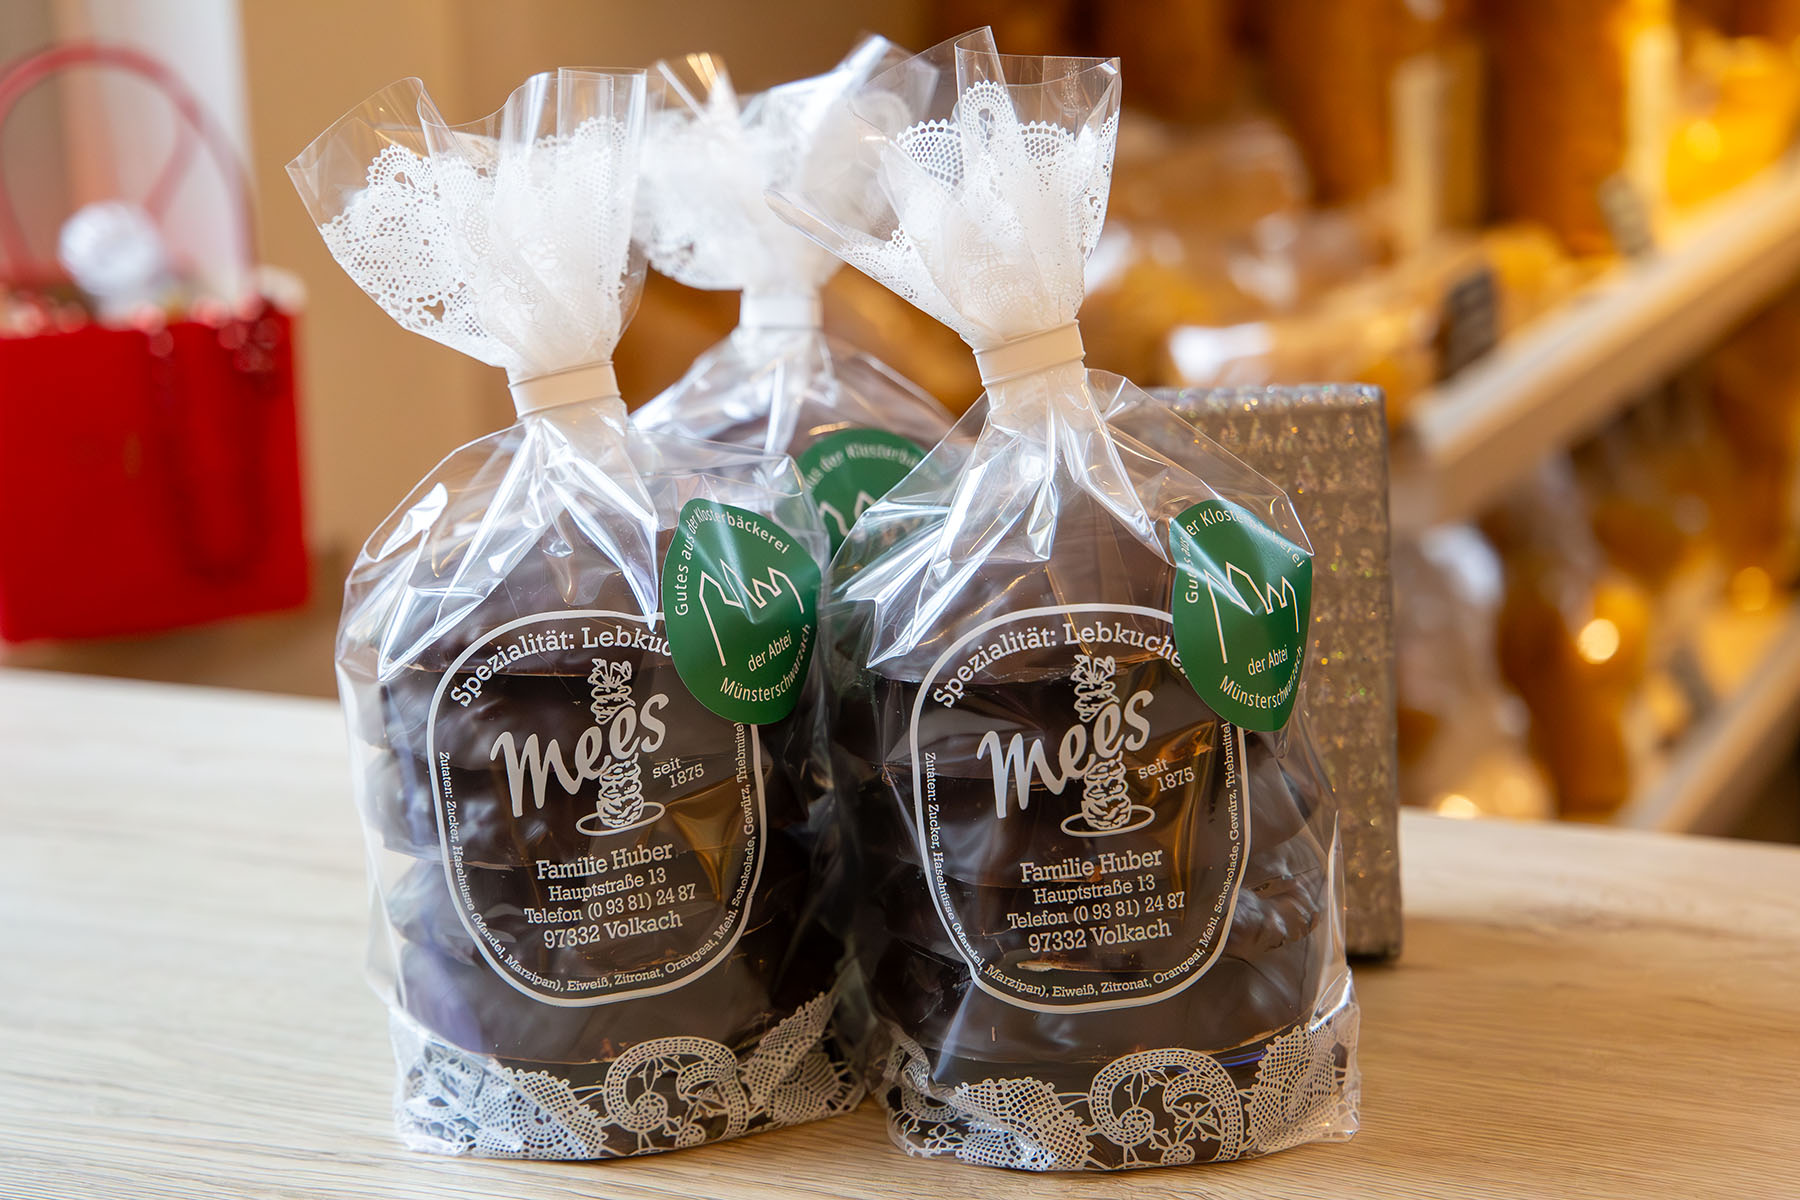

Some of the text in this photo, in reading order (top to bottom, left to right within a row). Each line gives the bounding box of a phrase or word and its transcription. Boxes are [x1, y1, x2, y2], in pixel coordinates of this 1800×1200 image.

[675, 506, 790, 615] Gutes aus der Klosterbäckerei
[450, 629, 575, 708] Spezialität:
[748, 629, 792, 672] der Abtei
[933, 621, 1186, 708] Spezialität: Lebkuche
[1248, 643, 1288, 675] der Abtei
[439, 751, 453, 798] Zutaten:
[652, 757, 682, 778] seit
[668, 763, 705, 789] 1875
[925, 752, 937, 802] Zutaten:
[1138, 758, 1169, 780] seit
[1157, 766, 1195, 793] 1875
[446, 800, 460, 843] Zucker,
[741, 784, 754, 835] Gewürz,
[928, 804, 941, 849] Zucker,
[1228, 789, 1239, 840] Gewürz,
[452, 845, 475, 911] Haselnüsse
[536, 842, 674, 880] Familie Huber
[732, 836, 756, 907] Schokolade,
[1020, 848, 1163, 884] Familie Huber
[1214, 842, 1240, 913] Schokolade,
[524, 883, 697, 925] Telefon (0 93 81) 24 87
[548, 867, 667, 903] Hauptstraße 13
[932, 851, 955, 921] Haselnüsse
[1033, 873, 1156, 907] Hauptstraße 13
[543, 910, 683, 950] 97332 Volkach
[1007, 891, 1186, 930] Telefon (0 93 81) 24 87
[1028, 919, 1172, 954] 97332 Volkach
[1199, 916, 1220, 948] Mehl,
[504, 953, 564, 992] Marzipan),
[665, 938, 719, 974] Orangeat,
[1153, 948, 1205, 984] Orangeat,
[614, 968, 665, 986] Zitronat,
[985, 963, 1050, 998] Marzipan),
[1101, 976, 1152, 994] Zitronat,
